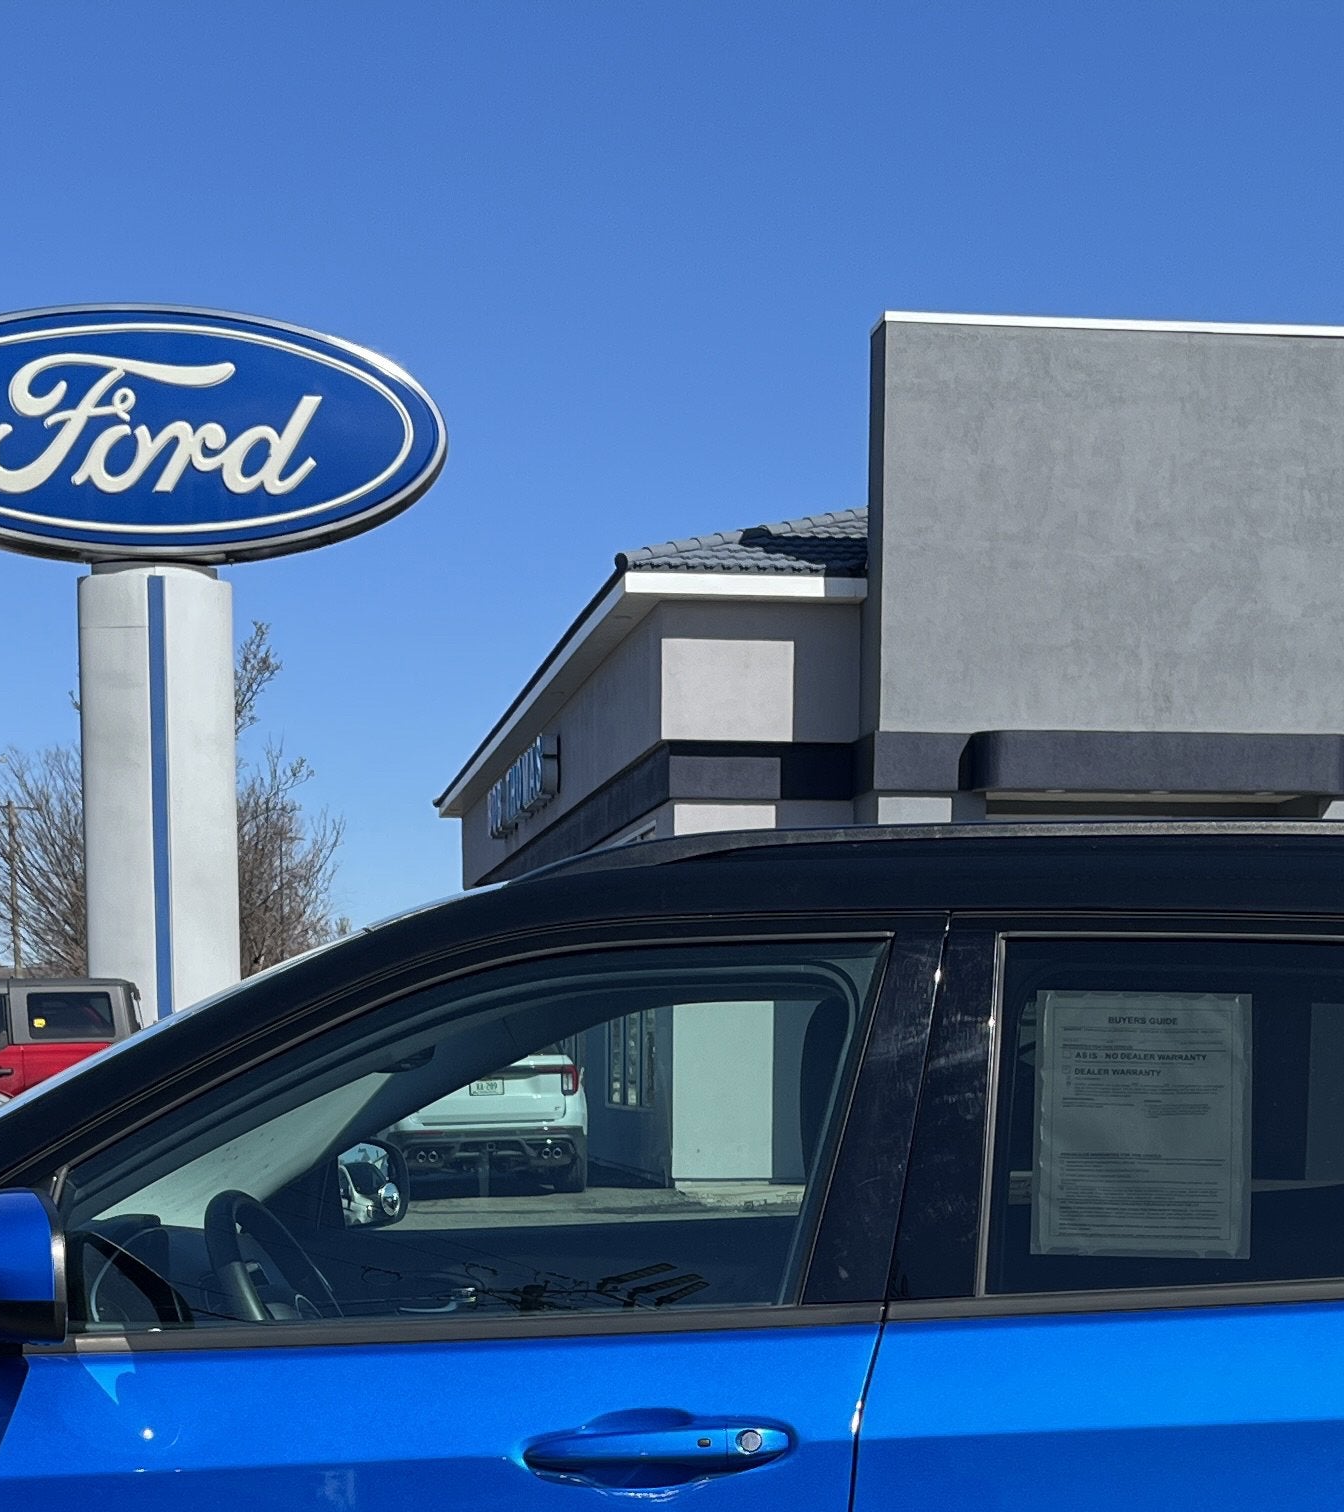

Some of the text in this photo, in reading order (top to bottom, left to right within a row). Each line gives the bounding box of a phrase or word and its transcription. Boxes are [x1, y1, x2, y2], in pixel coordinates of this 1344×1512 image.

[1108, 1016, 1178, 1026] BUYERS GUIDE
[1105, 1052, 1117, 1061] NO
[1120, 1053, 1155, 1061] DEALER
[1157, 1053, 1207, 1062] WARRANTY
[1074, 1068, 1161, 1077] DEALER WARRANTY
